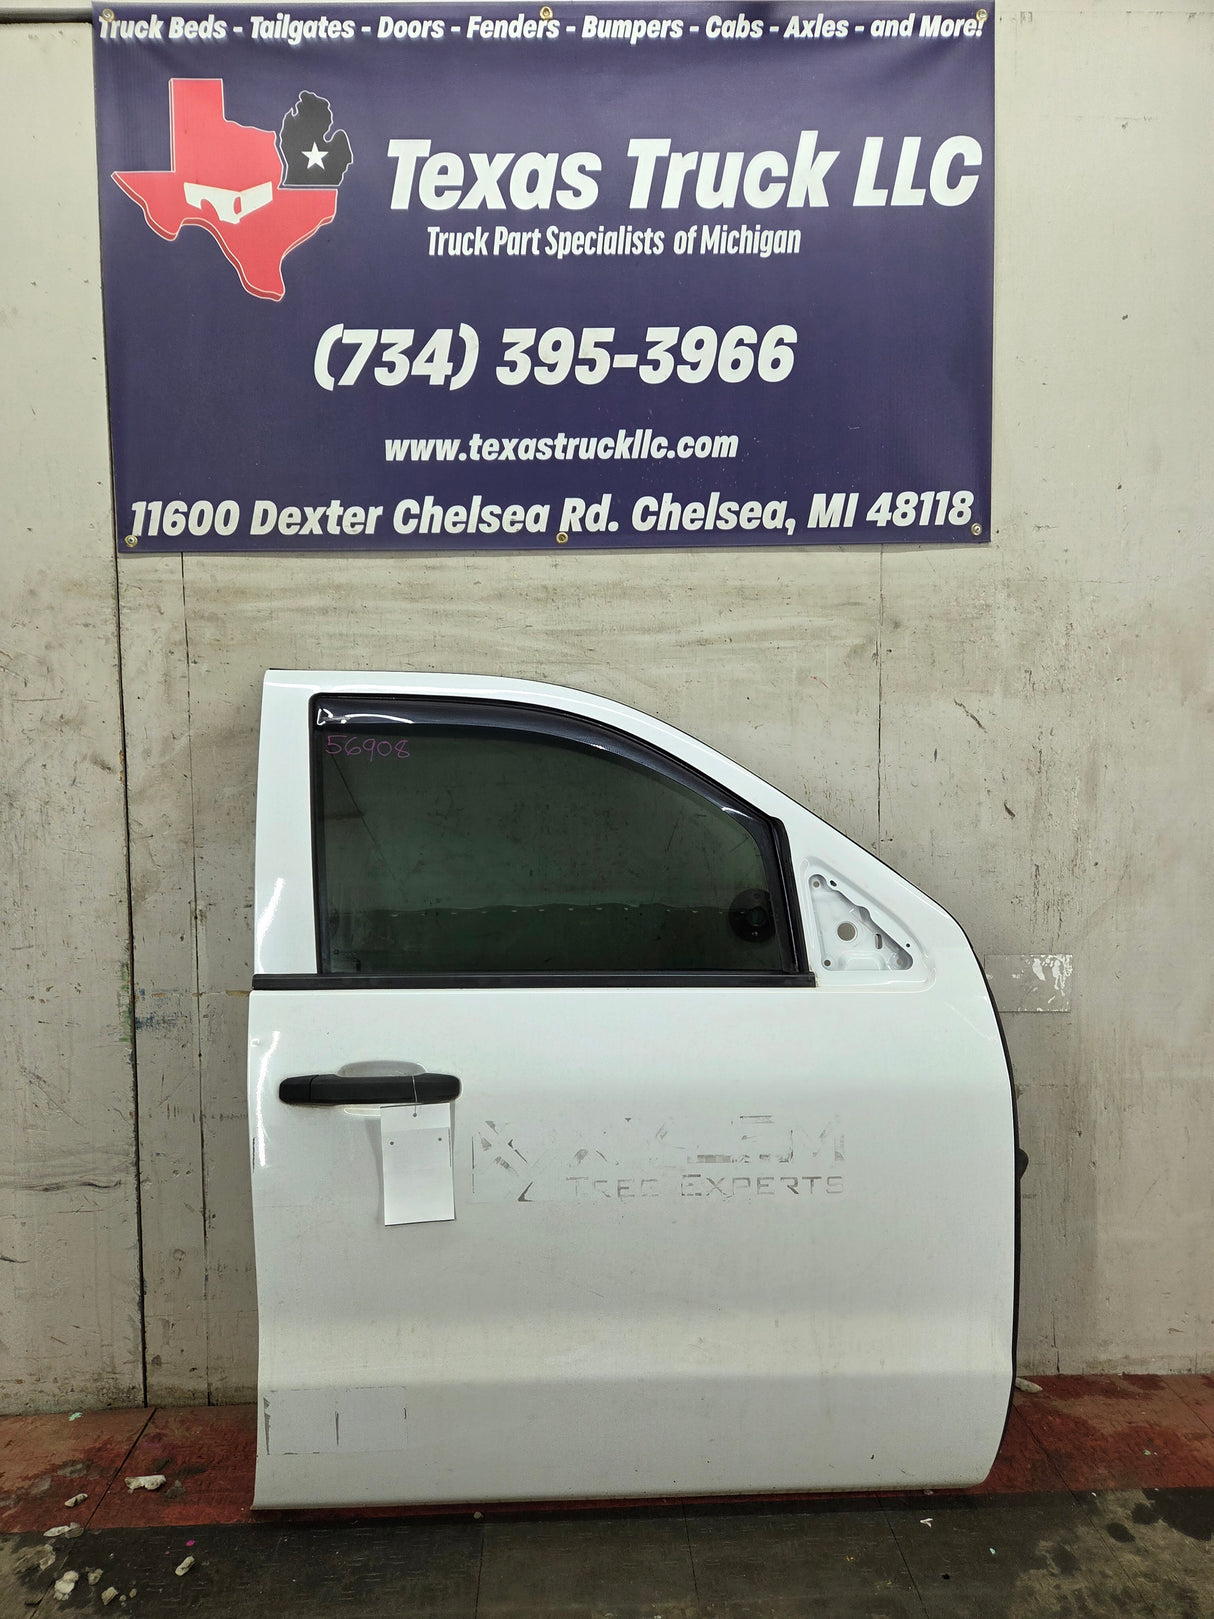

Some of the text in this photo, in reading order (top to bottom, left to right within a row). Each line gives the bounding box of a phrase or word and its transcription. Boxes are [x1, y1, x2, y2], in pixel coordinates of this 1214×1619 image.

[98, 14, 164, 39] Truck
[168, 16, 227, 39] Beds
[251, 13, 355, 45] Tailgates
[377, 16, 445, 39] Doors
[466, 13, 561, 39] Fenders
[582, 14, 683, 44] Bumpers
[705, 14, 763, 39] Cabs
[783, 13, 849, 38] Axles
[870, 13, 915, 37] and
[919, 14, 986, 38] More!
[386, 130, 983, 210] Texas Truck LLC
[427, 223, 802, 259] Truck Part Specialists of Michigan
[313, 322, 798, 391] (734) 395-3966
[384, 428, 739, 462] www.texastruckllc.com
[131, 490, 975, 537] 11600 Dexter Chelsea Rd. Chelsea, MI 48118
[325, 734, 411, 762] 56908
